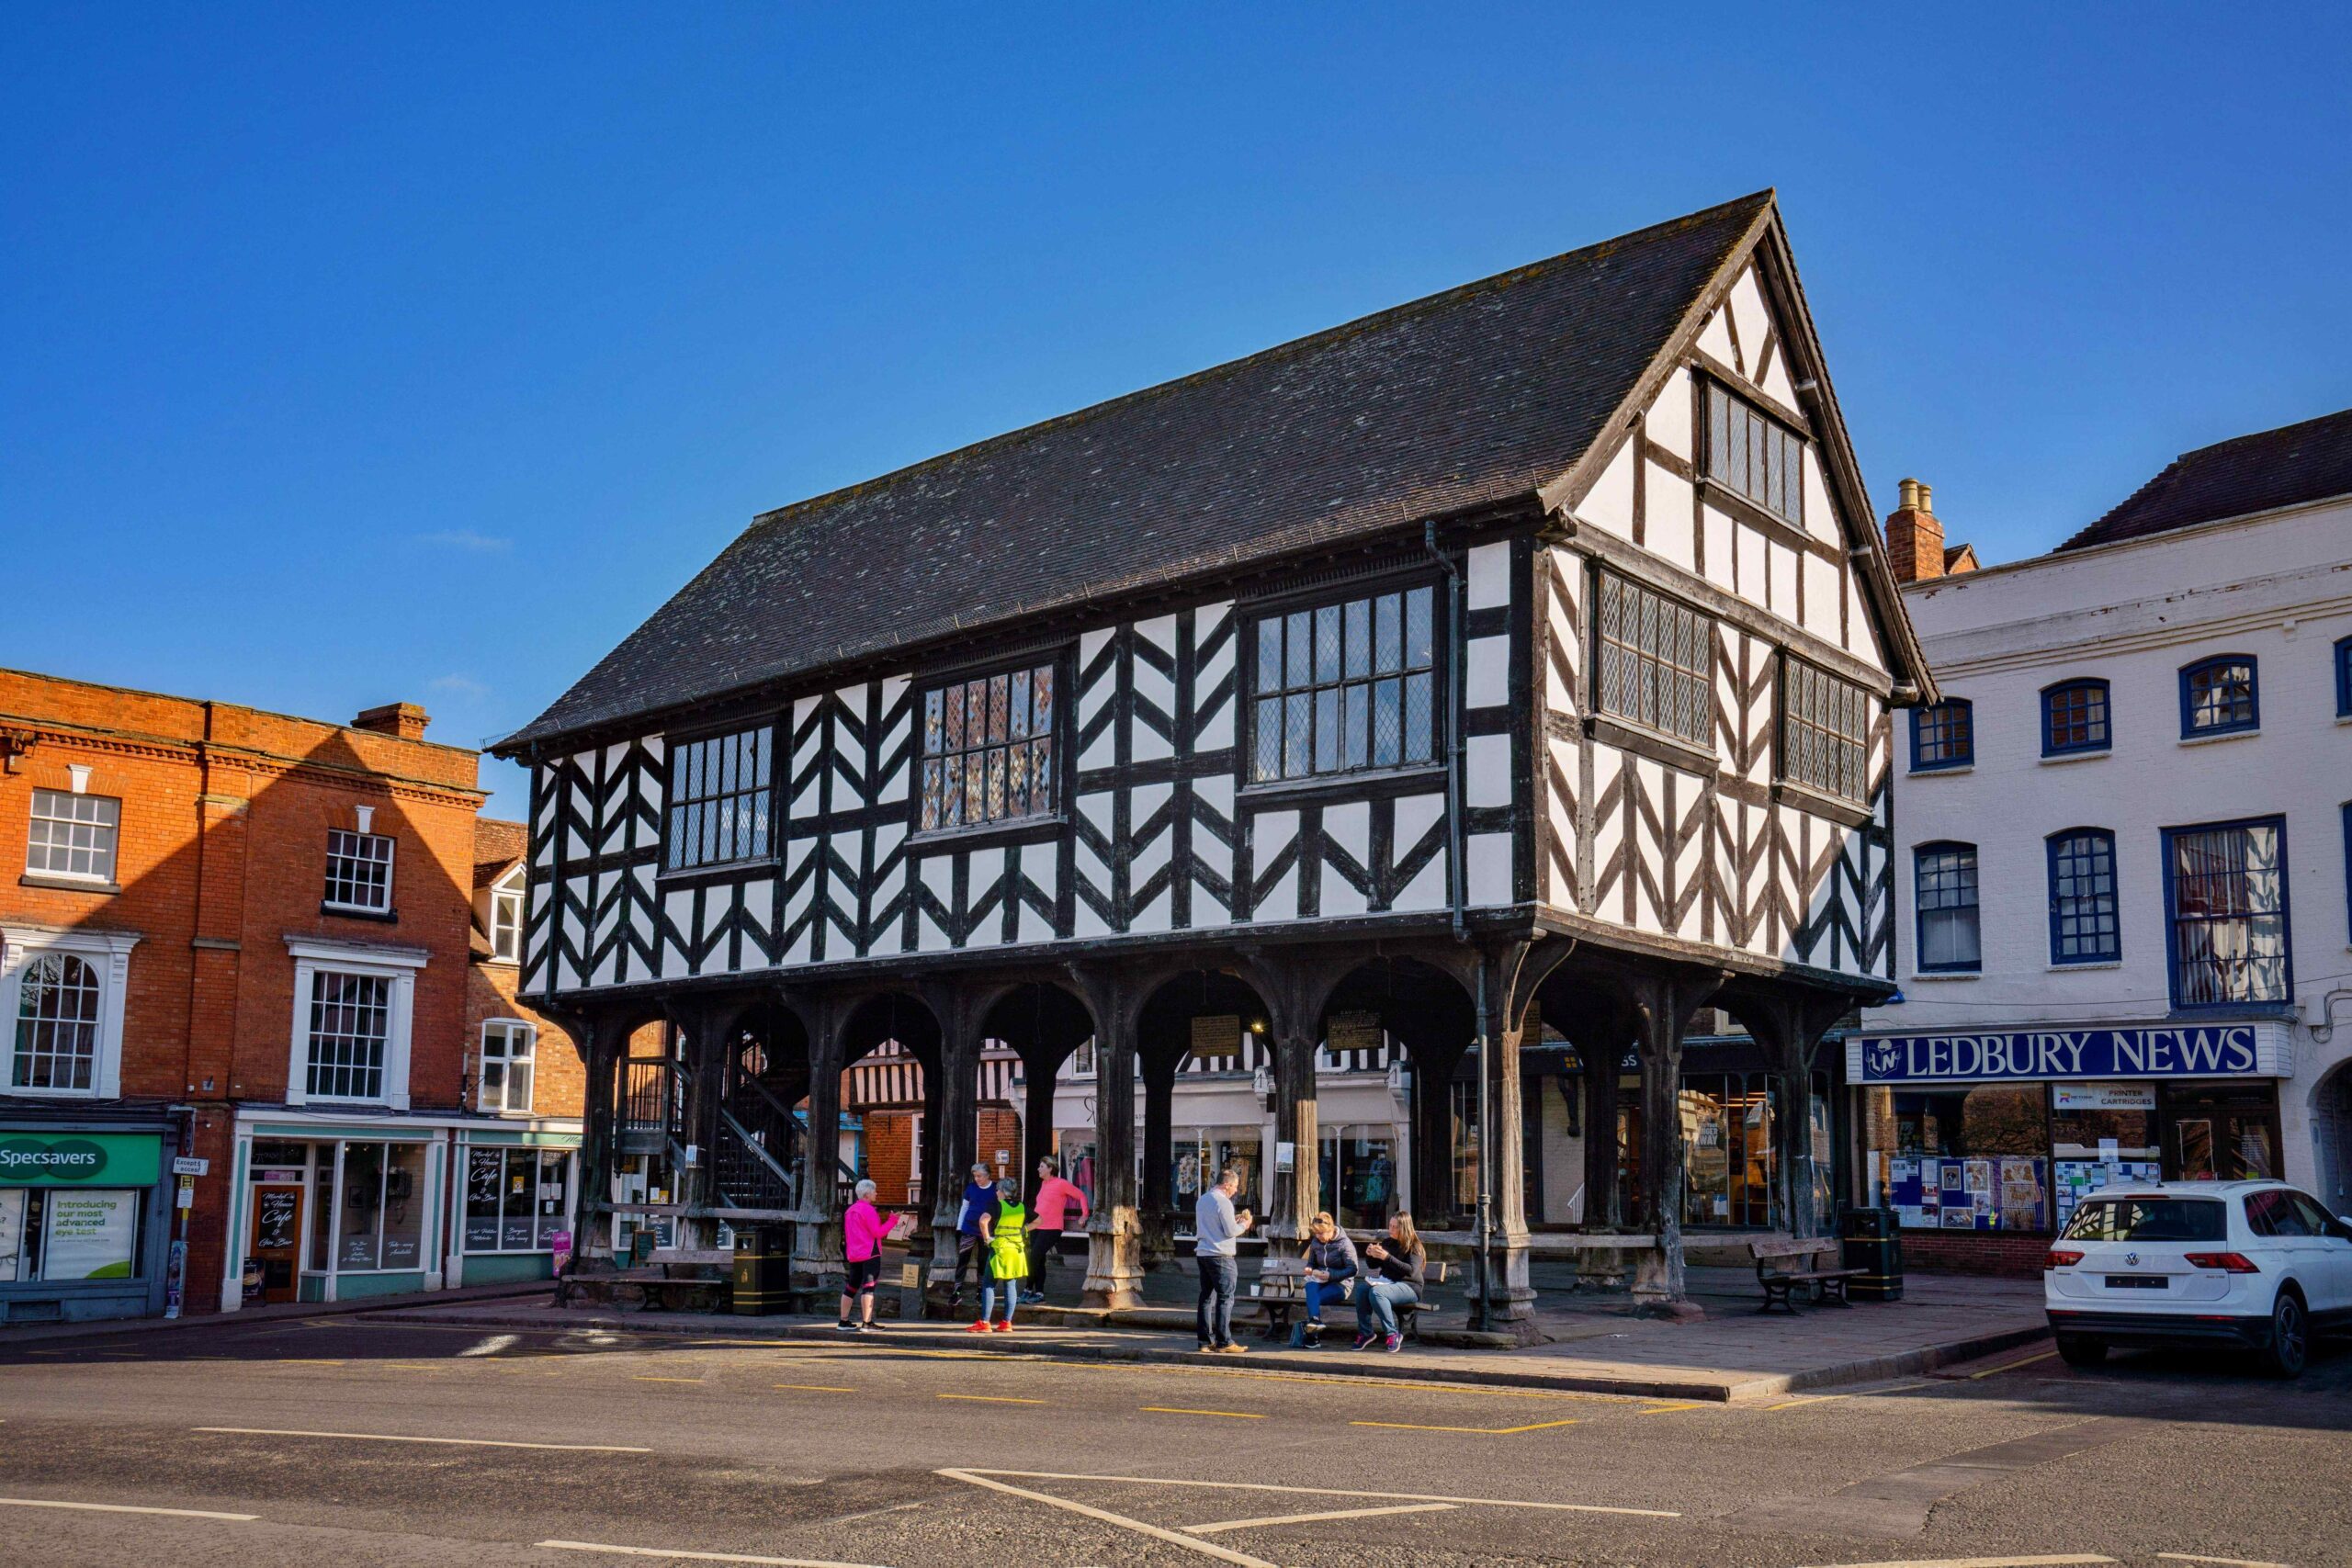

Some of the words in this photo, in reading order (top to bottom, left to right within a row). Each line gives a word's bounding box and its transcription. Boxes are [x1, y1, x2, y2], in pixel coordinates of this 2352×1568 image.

[1905, 1032, 2092, 1077] LEDBURY
[2111, 1028, 2254, 1072] NEWS
[1871, 1050, 1896, 1073] LN
[0, 1149, 96, 1168] Specsavers
[175, 1158, 197, 1167] Except
[182, 1176, 192, 1187] H
[470, 1168, 498, 1186] Cafe
[262, 1192, 288, 1201] Market
[57, 1200, 118, 1211] Introducing
[271, 1200, 294, 1208] House
[56, 1218, 106, 1227] advanced
[262, 1209, 292, 1227] Cafe
[54, 1229, 74, 1237] eye
[258, 1237, 274, 1247] Gin
[274, 1237, 293, 1247] Bar
